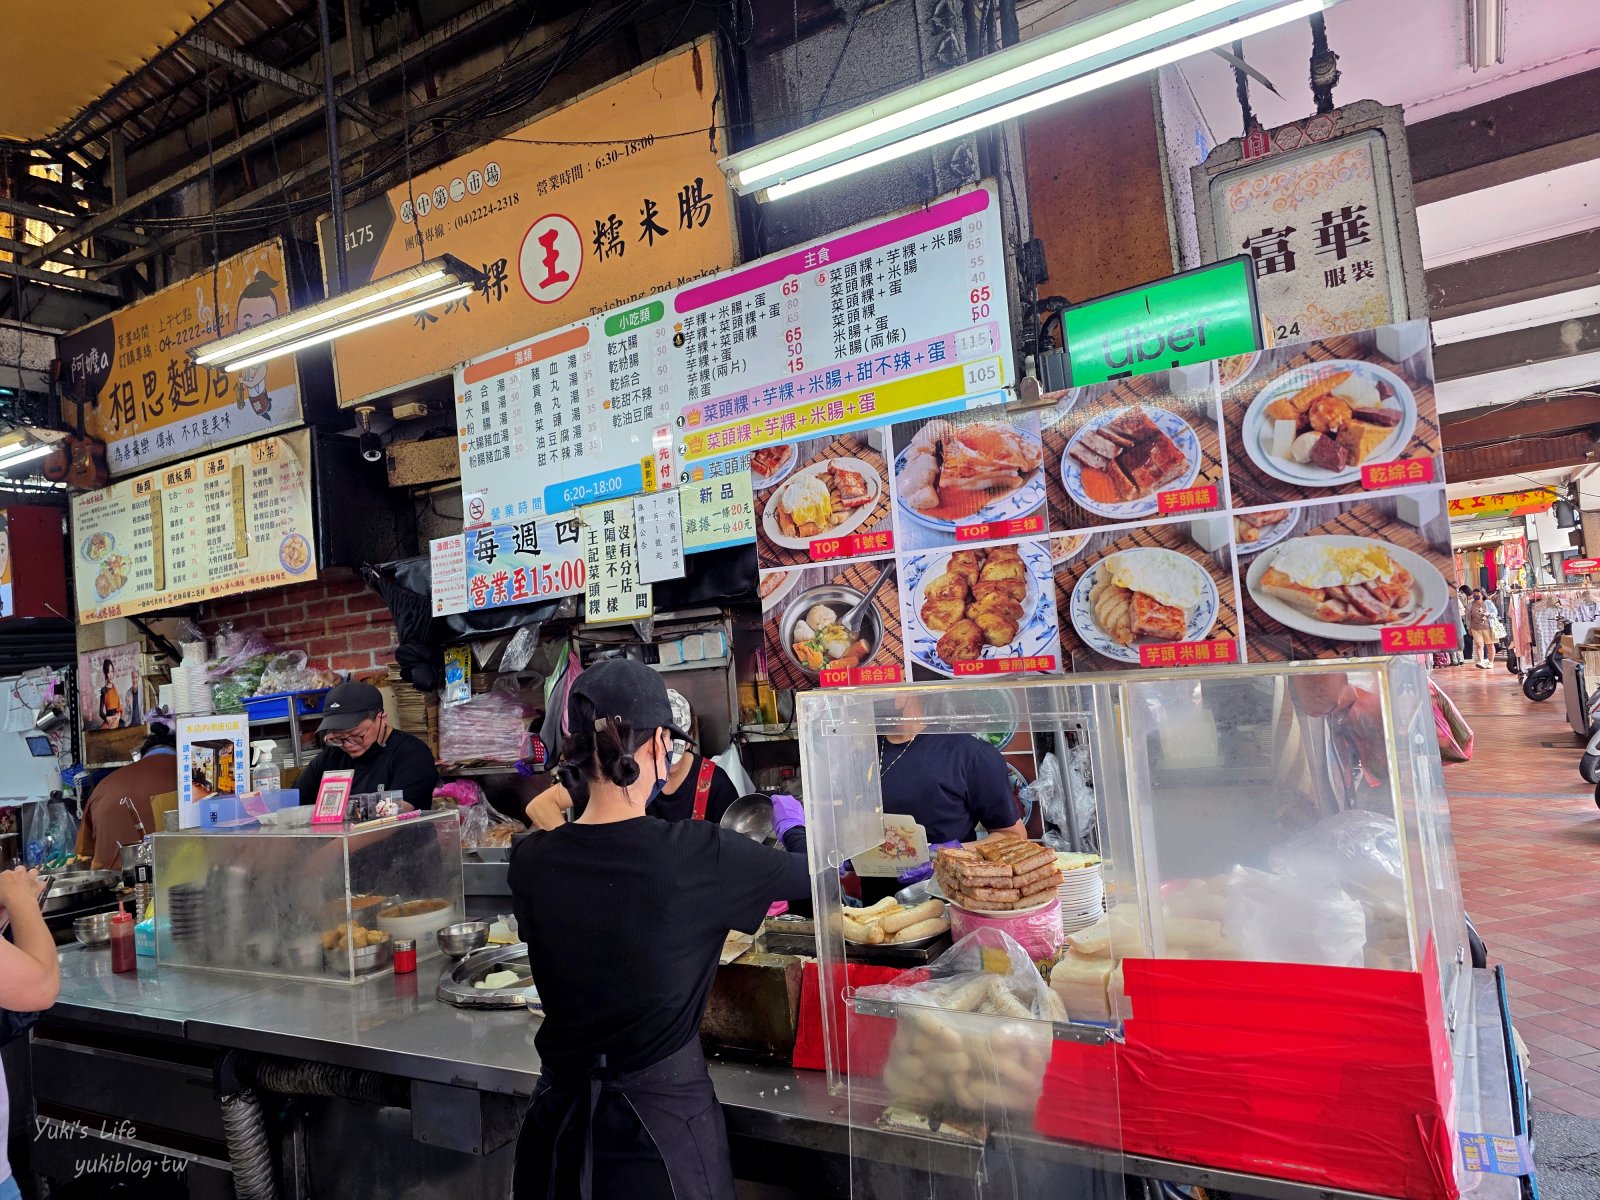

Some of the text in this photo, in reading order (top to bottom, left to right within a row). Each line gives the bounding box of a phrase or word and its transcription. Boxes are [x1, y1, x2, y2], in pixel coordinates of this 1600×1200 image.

[402, 165, 499, 222] 臺中第二市場
[592, 177, 714, 263] 糯米腸
[818, 272, 827, 284] 5
[967, 220, 983, 233] 90
[967, 238, 982, 250] 65
[1242, 205, 1372, 279] 富華
[538, 228, 570, 290] 王
[804, 247, 830, 269] 主食
[970, 255, 984, 268] 55
[1324, 260, 1375, 290] 服裝
[590, 264, 722, 315] Taichung 2nd Market
[782, 279, 799, 297] 65
[970, 285, 991, 305] 65
[832, 271, 986, 329] 菜頭粿 40
[619, 308, 651, 330] 小吃類
[787, 312, 799, 324] 65
[971, 303, 990, 321] 50
[785, 326, 802, 343] 65
[960, 331, 987, 351] 115
[1273, 322, 1300, 340] 24
[607, 328, 666, 356] 乾大腸 50
[788, 342, 803, 357] 50
[1103, 317, 1212, 369] Uber
[515, 347, 533, 366] 湯類
[582, 351, 592, 362] 35
[608, 346, 667, 374] 乾粉腸 50
[509, 374, 519, 385] 50
[583, 370, 593, 380] 35
[610, 365, 668, 392] 乾綜合 50
[688, 357, 804, 401] 煎蛋 15
[968, 365, 996, 384] 105
[109, 359, 230, 432] 相思麵店
[511, 392, 520, 402] 50
[586, 387, 595, 397] 35
[611, 385, 669, 411] 乾甜不辣 50
[512, 408, 521, 419] 50
[587, 404, 597, 414] 35
[612, 402, 670, 429] 乾油豆腐 40
[181, 411, 232, 439] 不只是美味
[514, 426, 523, 436] 50
[588, 422, 597, 433] 35
[256, 445, 275, 461] 小菜
[515, 443, 524, 453] 50
[589, 440, 599, 450] 35
[207, 458, 225, 474] 湯品
[1369, 463, 1424, 485] 乾綜合
[491, 476, 623, 521] 營業時間 6:20~18:00
[699, 482, 734, 505] 新品
[1164, 489, 1211, 509] 芋頭糕
[713, 518, 753, 535] 一份40元
[960, 519, 1038, 538] TOP 三樣
[474, 517, 580, 565] 每週四
[814, 533, 888, 555] TOP 1號餐
[603, 509, 619, 613] 與隔壁不一樣
[618, 525, 632, 594] 沒有分店
[470, 558, 586, 607] 營業至15:00
[587, 530, 601, 615] 王記菜頭粿
[1215, 641, 1230, 660] 蛋
[824, 667, 896, 683] TOP 綜合湯
[957, 661, 984, 673] TOP
